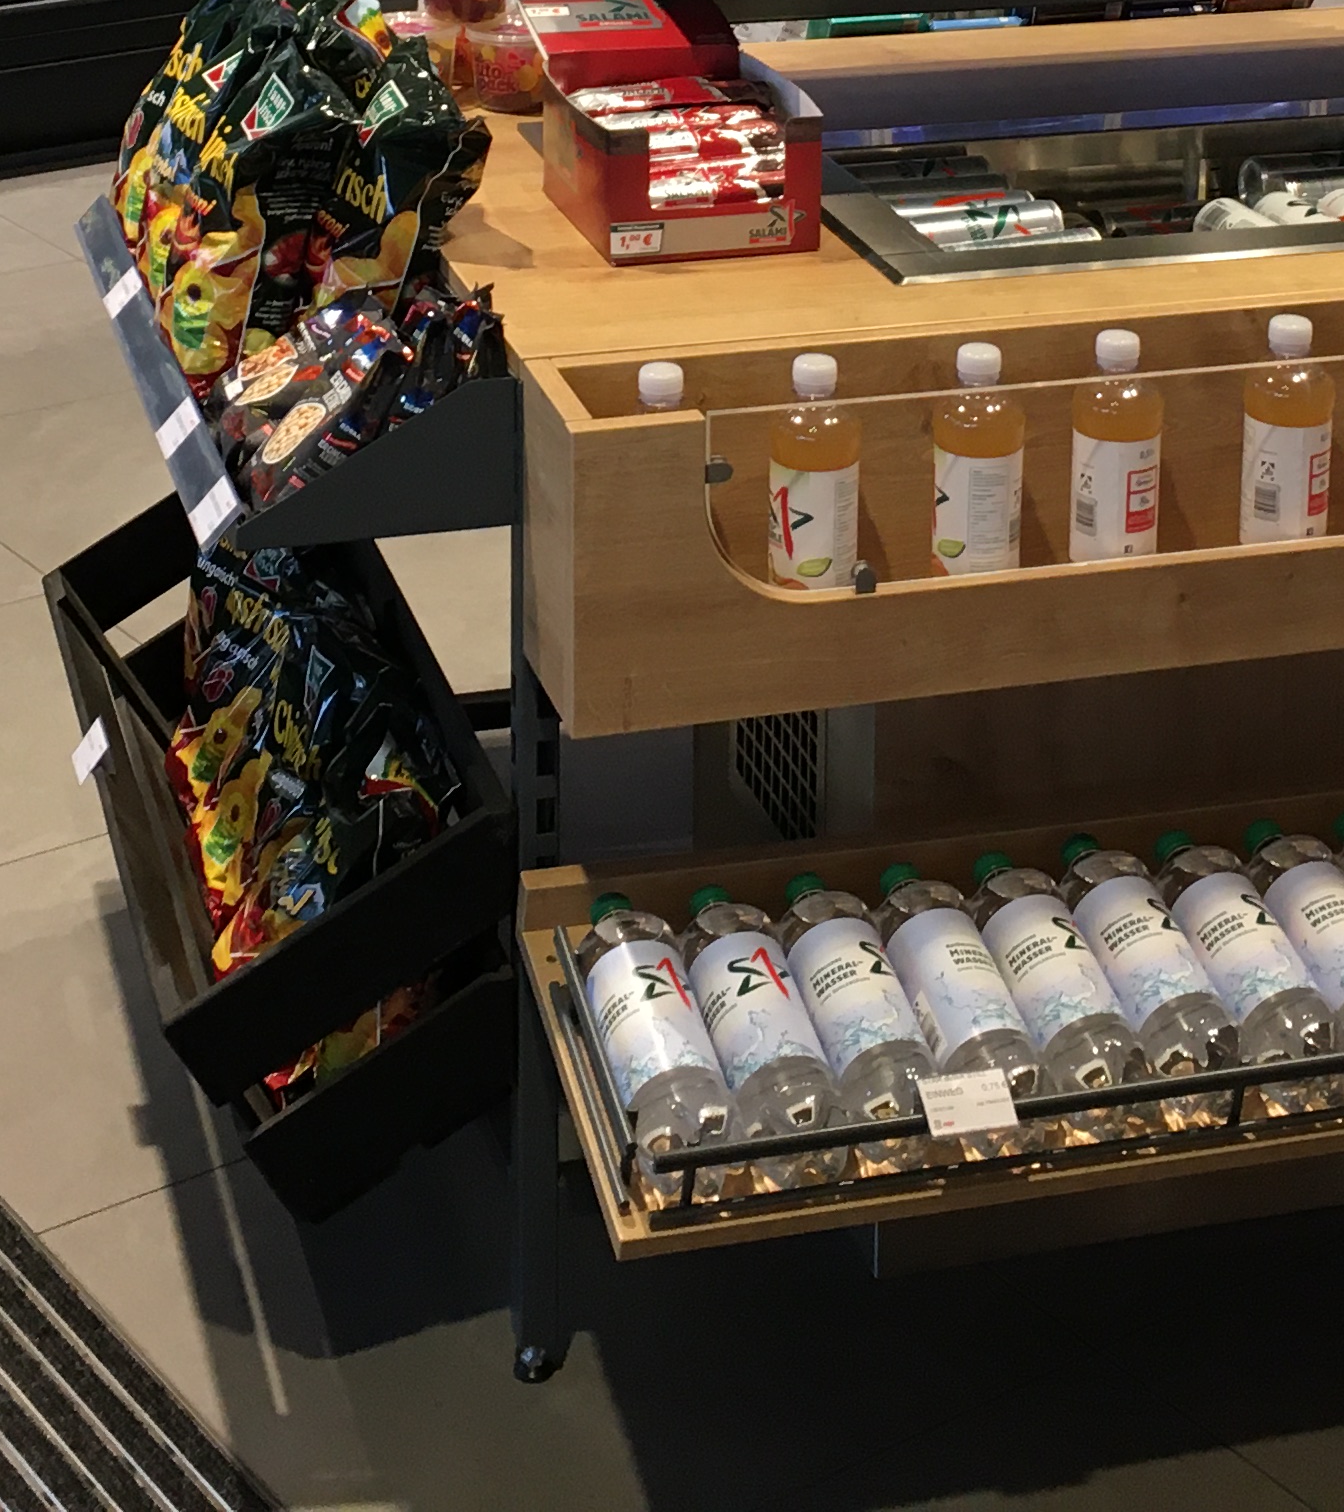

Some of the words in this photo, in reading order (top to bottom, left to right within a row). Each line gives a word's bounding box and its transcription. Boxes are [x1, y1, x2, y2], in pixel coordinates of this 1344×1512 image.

[576, 10, 650, 22] SALAMI
[749, 227, 787, 238] SALAMI
[1102, 913, 1155, 944] MINERAL-
[1108, 924, 1151, 952] WASSER
[1199, 912, 1249, 942] MINERAL-
[1204, 921, 1246, 952] WASSER
[1008, 936, 1057, 967] MINERAL-
[1013, 945, 1052, 975] WASSER
[812, 960, 864, 989] MINERAL-
[816, 969, 857, 998] WASSER
